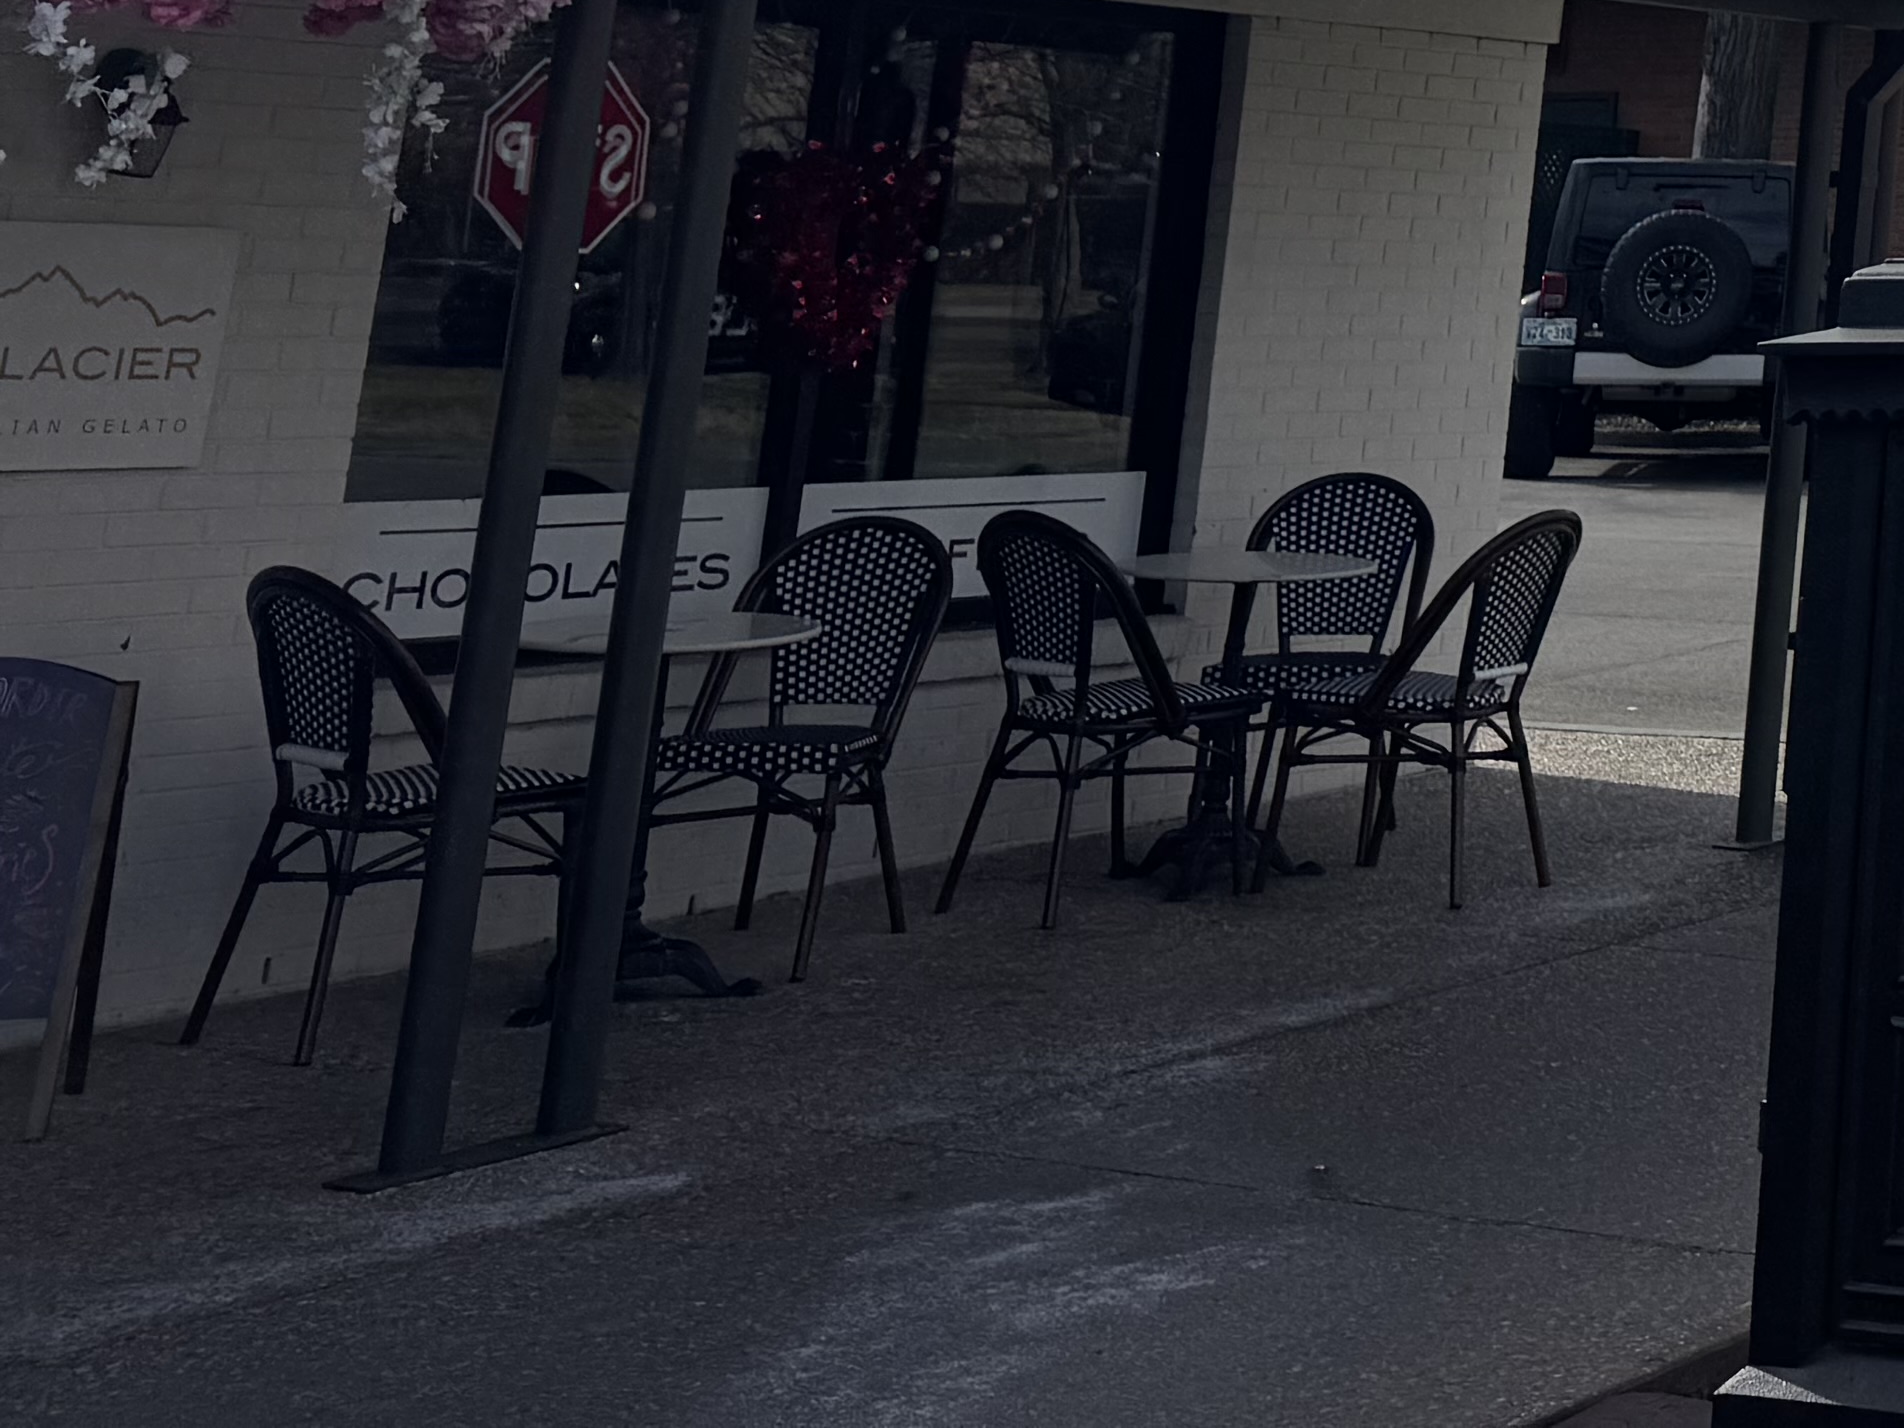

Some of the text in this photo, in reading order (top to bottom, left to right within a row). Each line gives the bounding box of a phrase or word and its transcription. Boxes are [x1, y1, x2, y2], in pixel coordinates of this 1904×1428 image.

[0, 418, 189, 435] IAN GELATO
[341, 552, 731, 611] CHOOLAES
